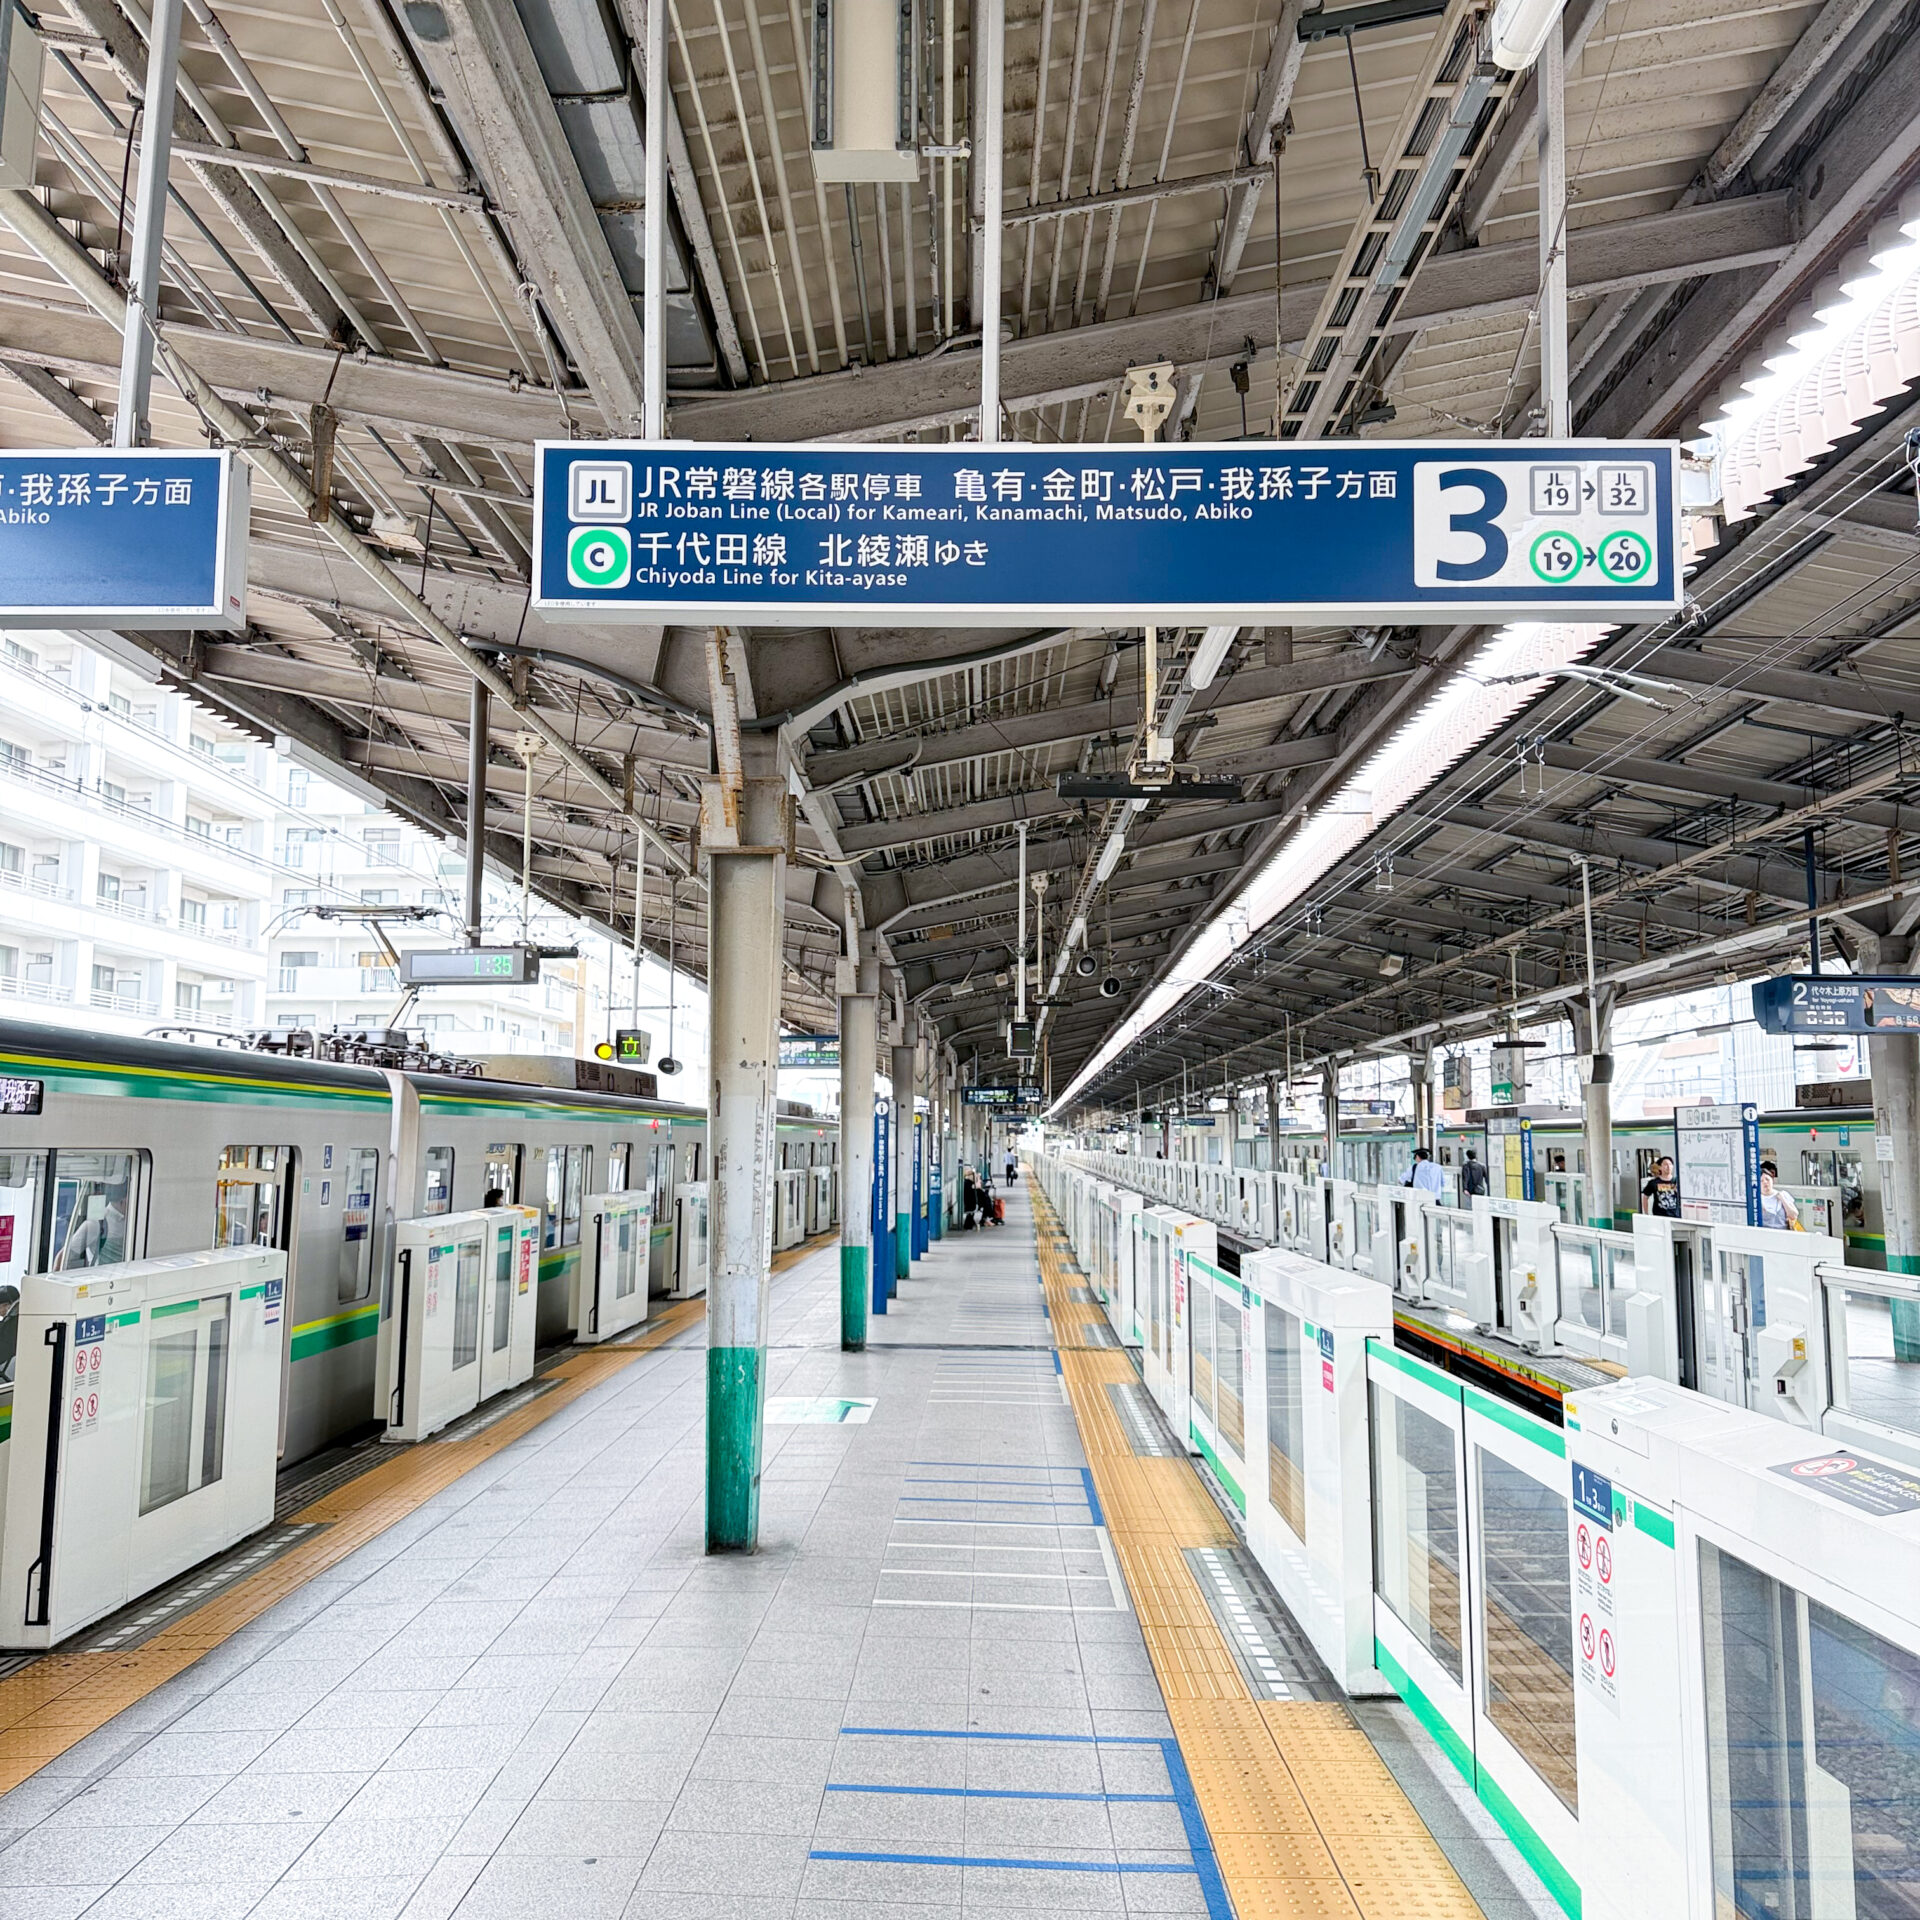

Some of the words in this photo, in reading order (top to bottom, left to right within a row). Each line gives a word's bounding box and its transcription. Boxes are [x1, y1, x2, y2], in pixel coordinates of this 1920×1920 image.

[639, 467, 922, 501] JR常磐線各駅停車
[1548, 473, 1564, 486] JL
[1615, 473, 1631, 486] JL
[586, 480, 616, 504] JL
[1544, 488, 1569, 506] 19
[1610, 488, 1637, 506] 32
[638, 503, 659, 518] JR
[664, 502, 723, 519] Joban
[731, 503, 770, 519] Line
[777, 503, 841, 523] (Local)
[847, 503, 877, 520] for
[884, 504, 969, 523] Kameari,
[977, 503, 1089, 523] Kanamachi,
[1096, 503, 1188, 522] Matsudo,
[1194, 503, 1253, 520] Abiko
[1436, 468, 1509, 581] 3
[638, 532, 787, 566] 千代田線
[819, 534, 989, 567] 北綾瀬ゆき
[1552, 539, 1561, 550] C
[1620, 539, 1629, 550] C
[589, 547, 605, 567] C
[1544, 552, 1573, 571] 19
[1609, 551, 1641, 571] 20
[637, 568, 716, 588] Chiyoda
[724, 569, 764, 585] Line
[770, 568, 800, 585] for
[806, 569, 908, 590] Kita-ayase
[474, 956, 512, 975] 1:35
[1793, 982, 1809, 1006] 2
[1811, 986, 1860, 996] 代々木上原方面
[1895, 1016, 1919, 1025] 8:58
